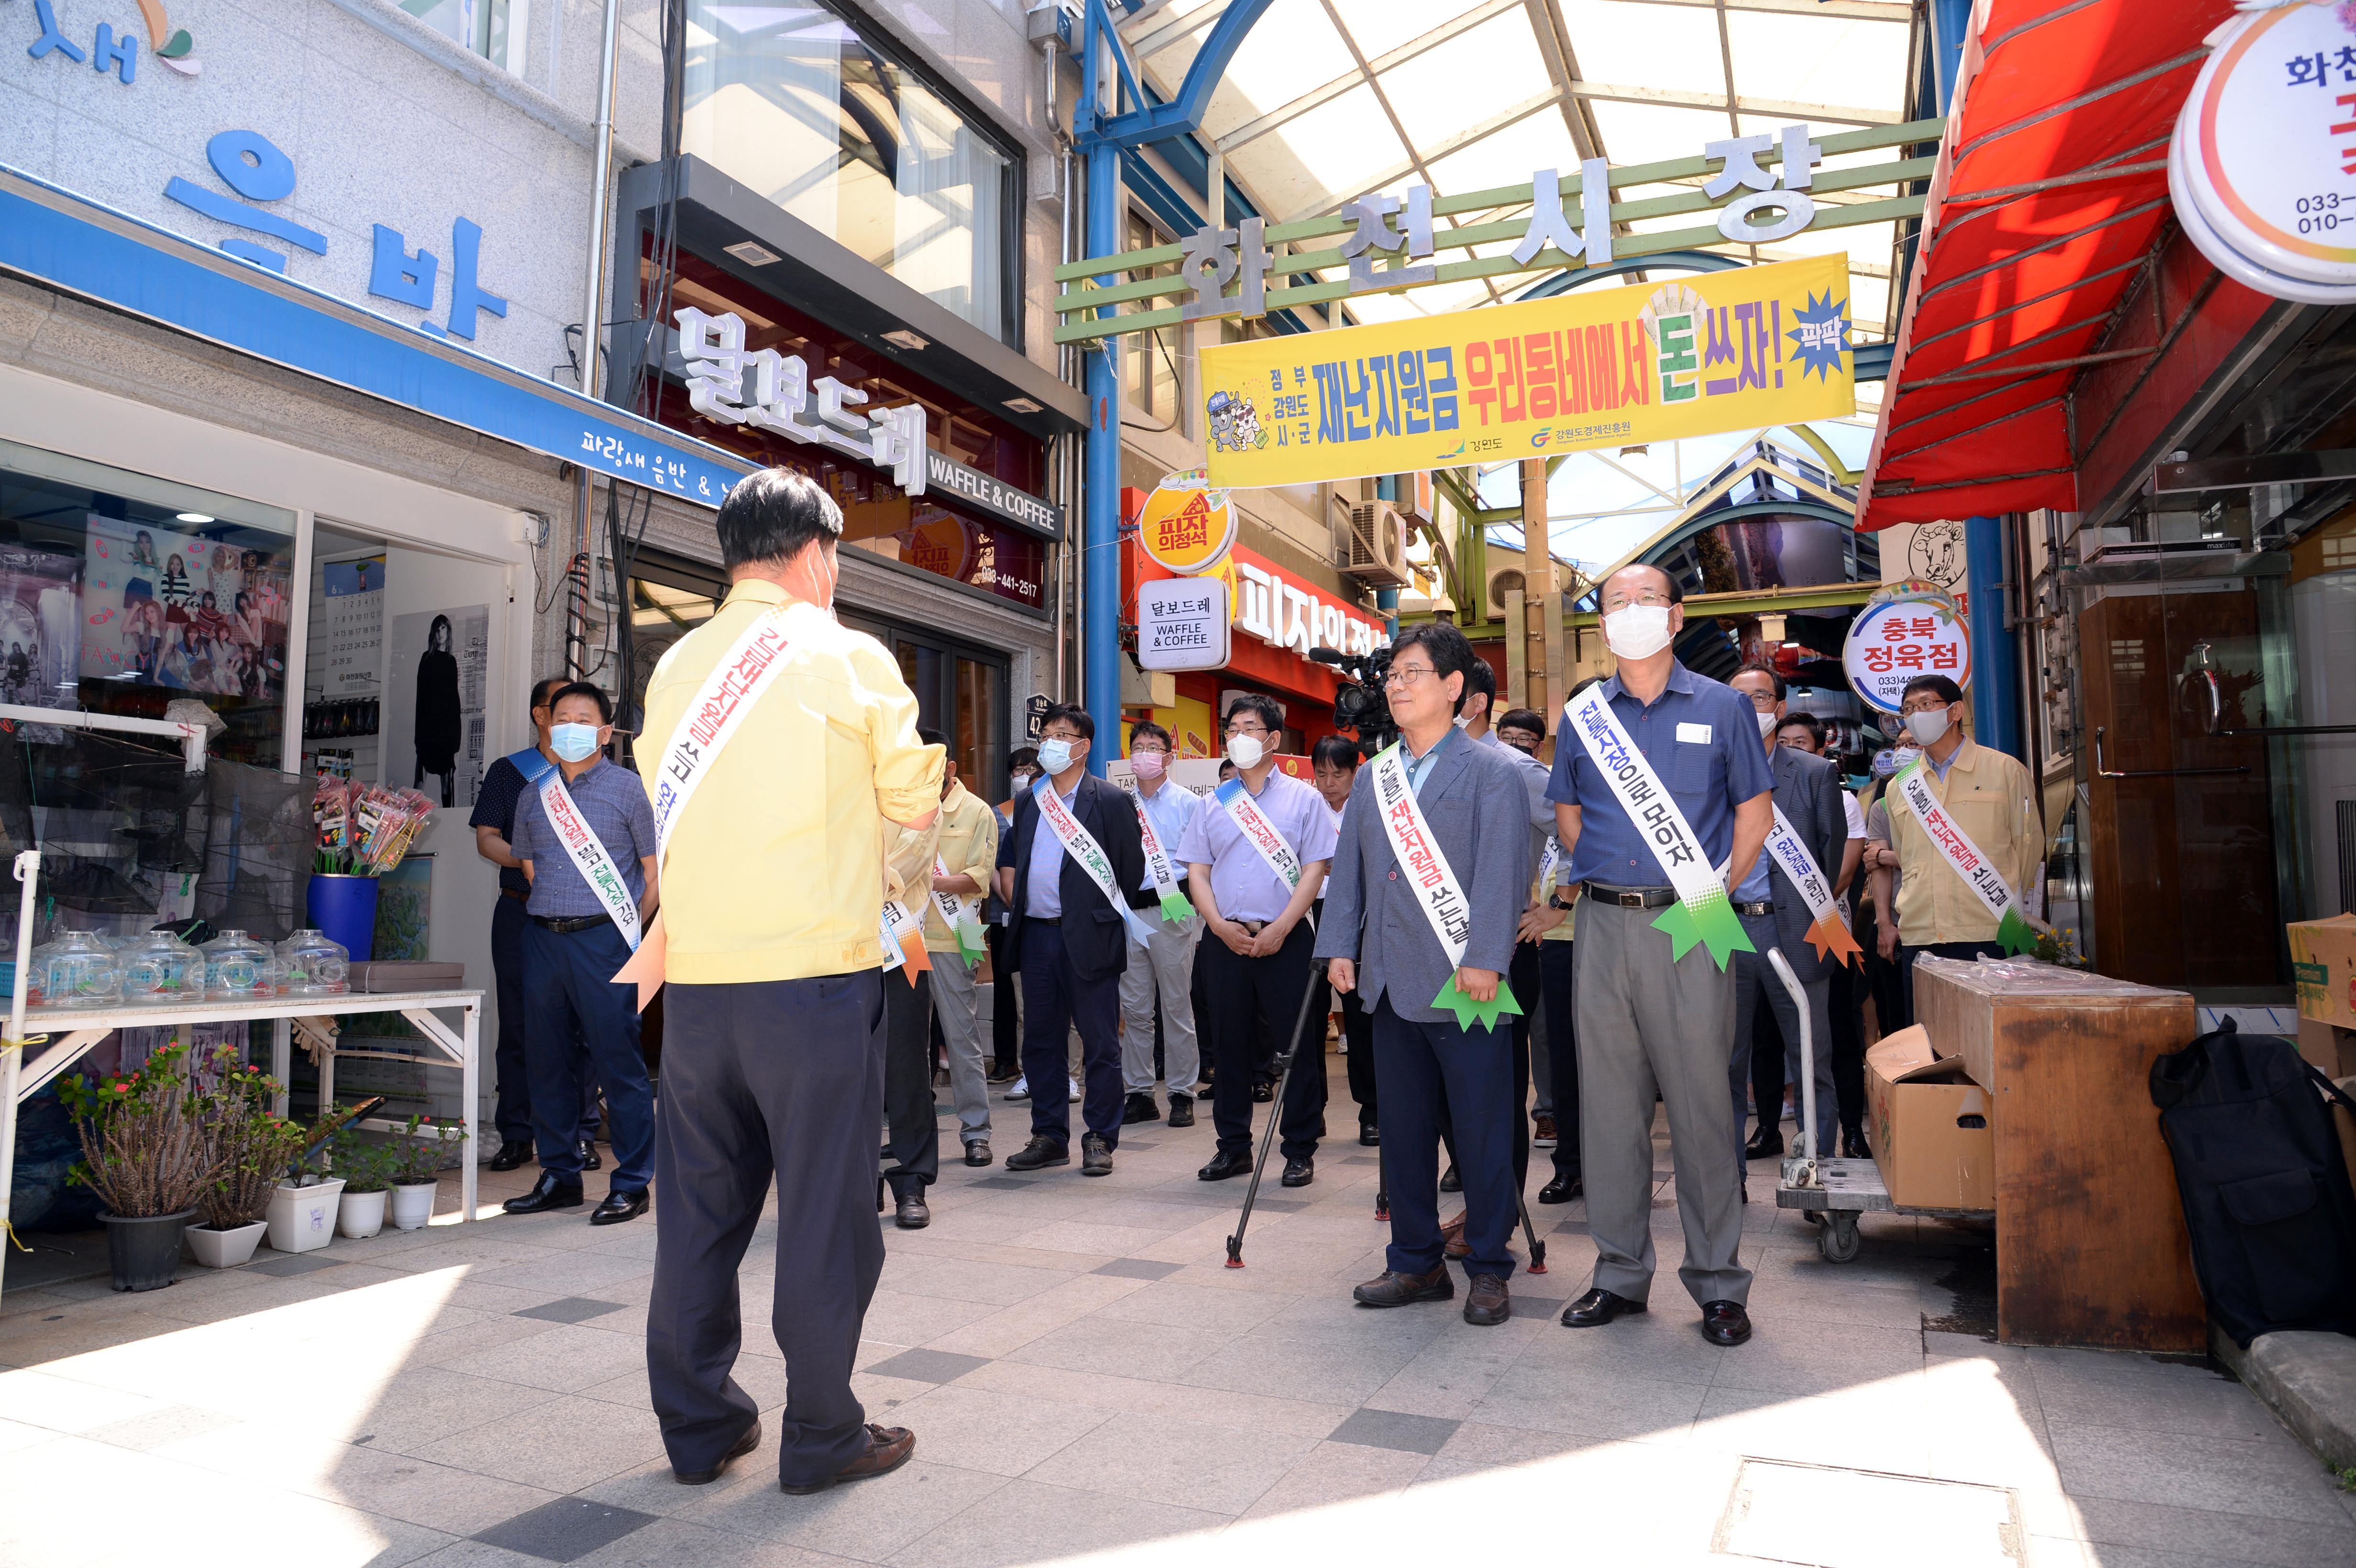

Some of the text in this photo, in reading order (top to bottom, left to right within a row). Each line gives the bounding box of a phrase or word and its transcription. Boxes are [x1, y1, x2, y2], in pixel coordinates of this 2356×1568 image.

[1311, 299, 1842, 445] 재난지원금 우리동네에서 돈 쓰자! 팍팍
[674, 306, 926, 496] 달보드레
[1273, 393, 1309, 419] 강원도
[1470, 438, 1503, 452] 강원도
[1556, 422, 1631, 439] 강원도경제진흥원
[581, 431, 711, 497] 파랑새 음반 &
[929, 455, 1055, 531] WAFFLE & COFFEE
[1158, 514, 1209, 535] 피자
[1159, 530, 1207, 551] 의정석
[2207, 541, 2235, 550] maxlife
[331, 585, 337, 594] 6
[982, 566, 1037, 598] 033-441-2517
[1151, 597, 1210, 616] 달보드레
[1153, 633, 1207, 647] & COFFEE
[1156, 623, 1201, 635] WAFFLE
[1881, 617, 1937, 642] 충북
[1863, 642, 1957, 672] 정육점
[689, 627, 789, 747] 긴급재난지원금
[667, 741, 699, 784] 쓰고
[1379, 758, 1403, 806] 오늘은
[1578, 699, 1696, 868] 전통시장으로 모이자
[1041, 789, 1078, 840] 긴급재난지원금
[1070, 833, 1092, 856] 받고
[1084, 849, 1112, 884] 전통시장
[1233, 800, 1281, 854] 긴급재난지원금
[1272, 848, 1294, 871] 받고
[1388, 798, 1444, 889] 재난지원금
[1907, 779, 2008, 907] 오늘은 재난지원금 쓰는날
[546, 784, 635, 927] 긴급재난지원금 받고 전통시장 가요
[1150, 853, 1170, 885] 쓰는날
[1775, 837, 1812, 879] 화천경제
[1803, 873, 1828, 907] 살리고
